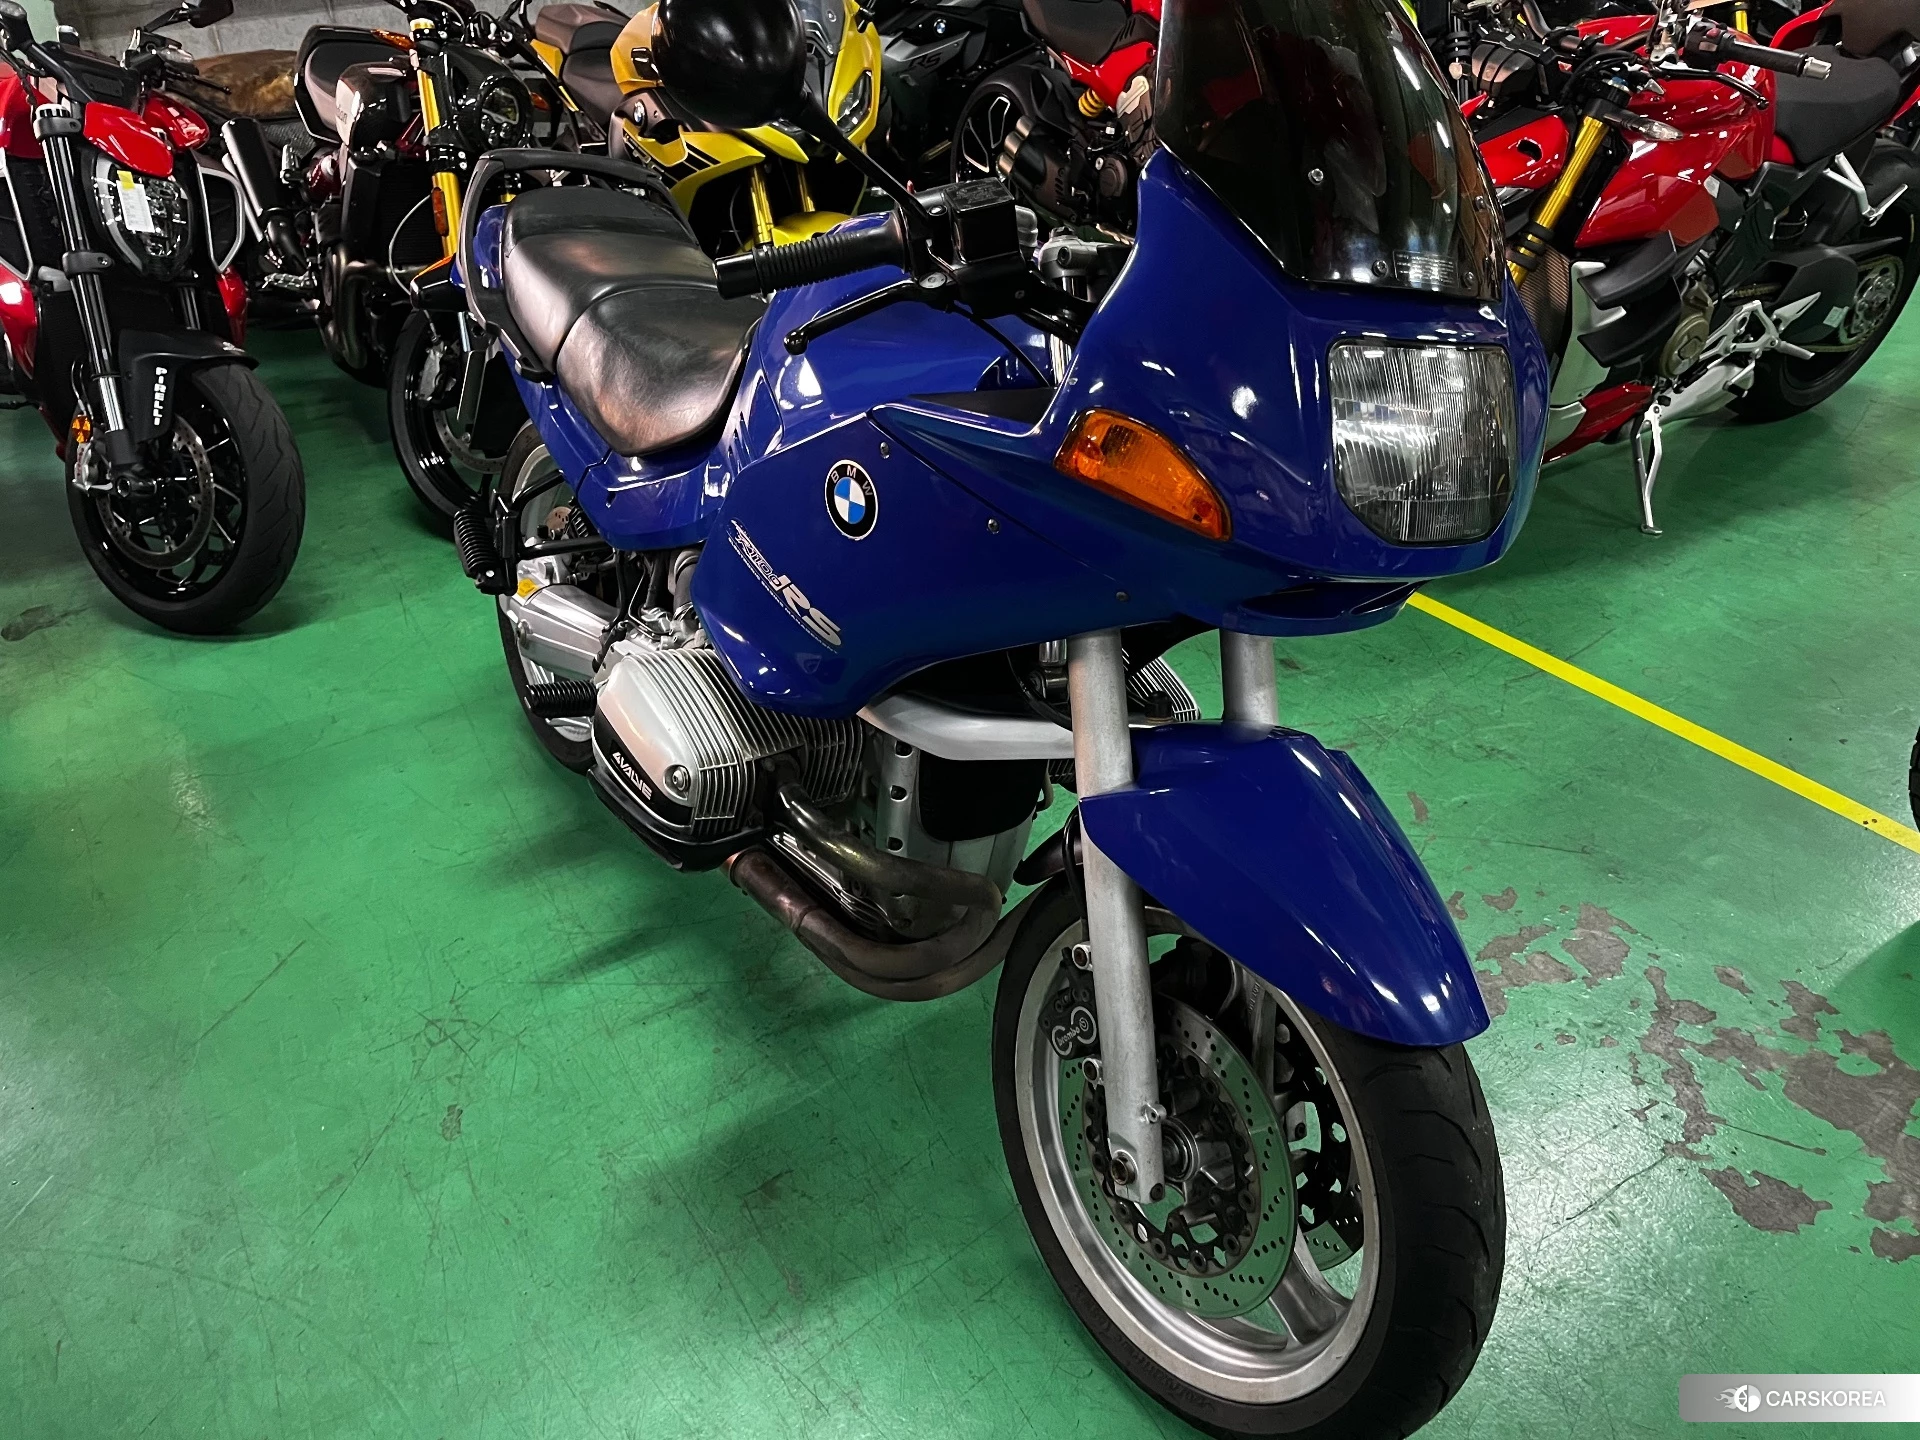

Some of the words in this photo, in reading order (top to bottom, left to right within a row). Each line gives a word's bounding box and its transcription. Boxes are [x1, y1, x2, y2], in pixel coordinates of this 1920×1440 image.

[908, 51, 943, 69] RS
[153, 366, 168, 426] PIRELLI
[830, 464, 873, 497] BMW
[1056, 1026, 1081, 1047] brembo
